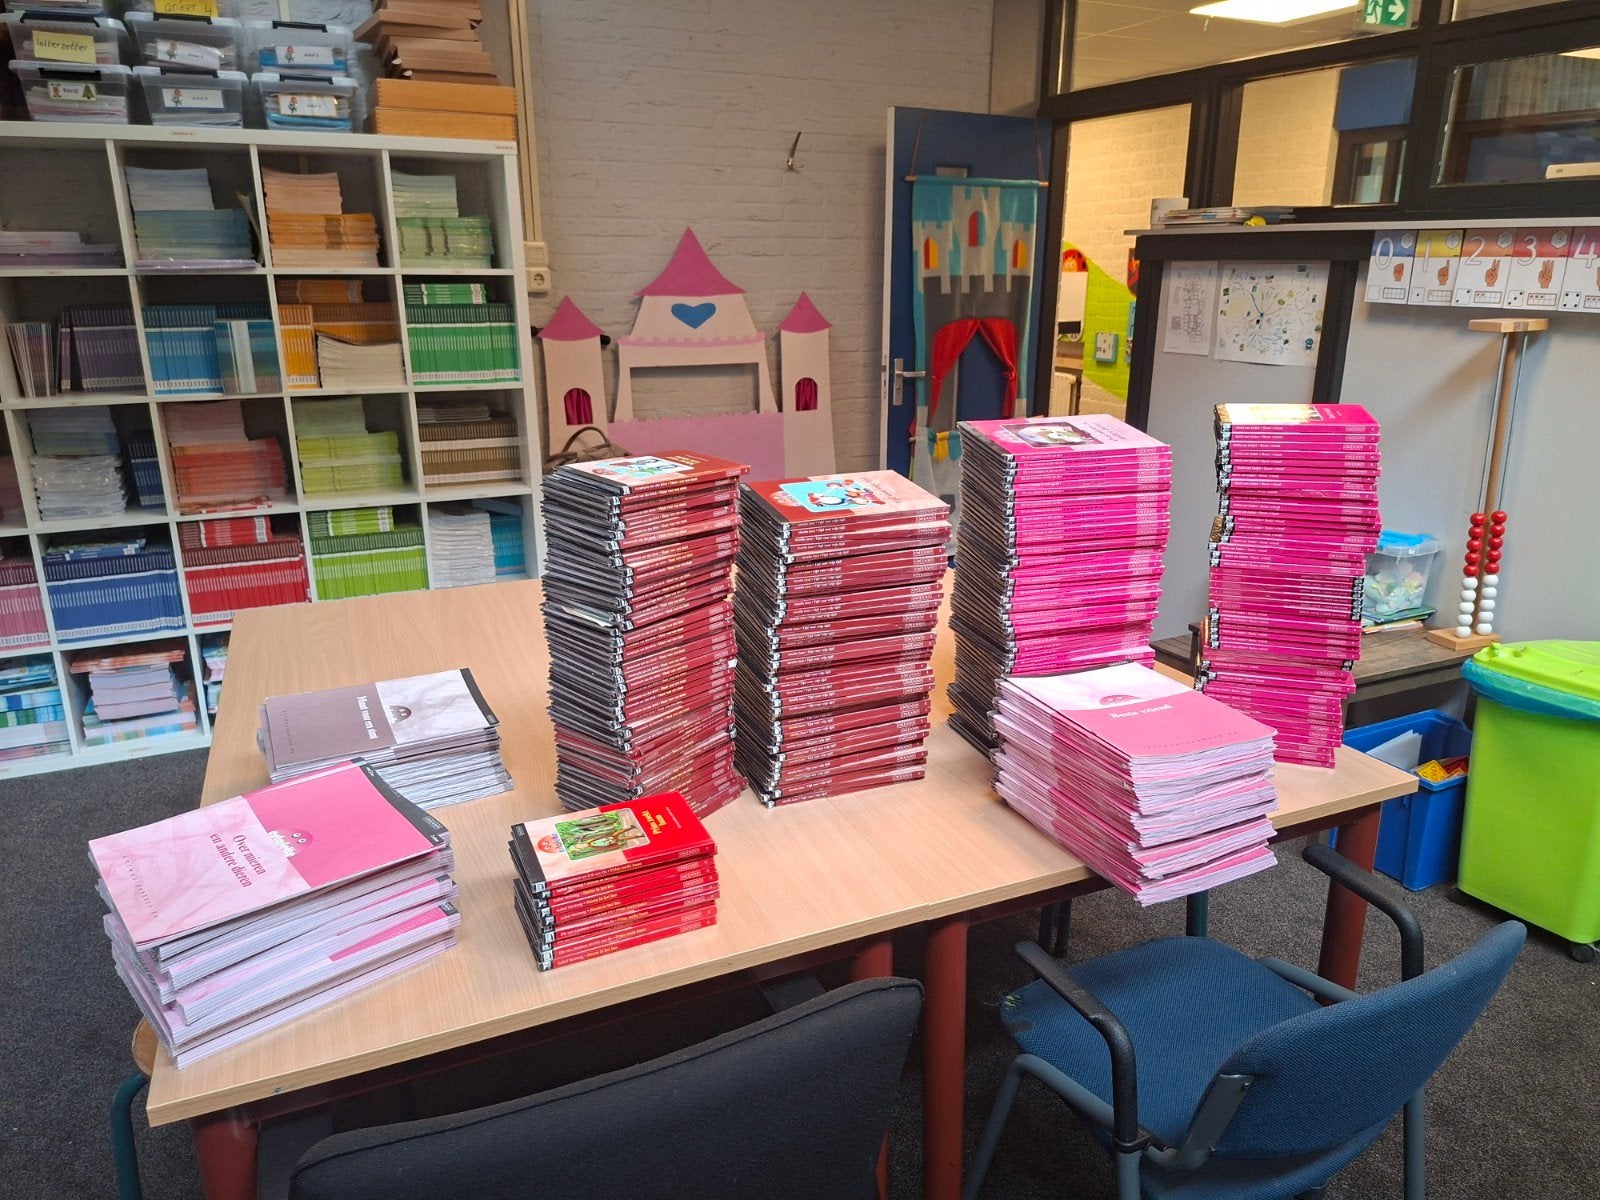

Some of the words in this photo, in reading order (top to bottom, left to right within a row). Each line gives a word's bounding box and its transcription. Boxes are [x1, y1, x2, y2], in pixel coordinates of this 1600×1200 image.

[204, 4, 212, 16] 4
[36, 38, 88, 52] letterzetter
[1375, 237, 1394, 270] 0
[1422, 238, 1432, 273] 1
[1464, 235, 1486, 266] 2
[1516, 235, 1538, 266] 3
[1573, 234, 1599, 268] 4
[1140, 704, 1172, 714] vriend
[210, 833, 222, 844] en
[216, 843, 237, 866] andere
[231, 866, 252, 887] dieren
[232, 834, 250, 852] Over
[244, 852, 266, 875] mieren
